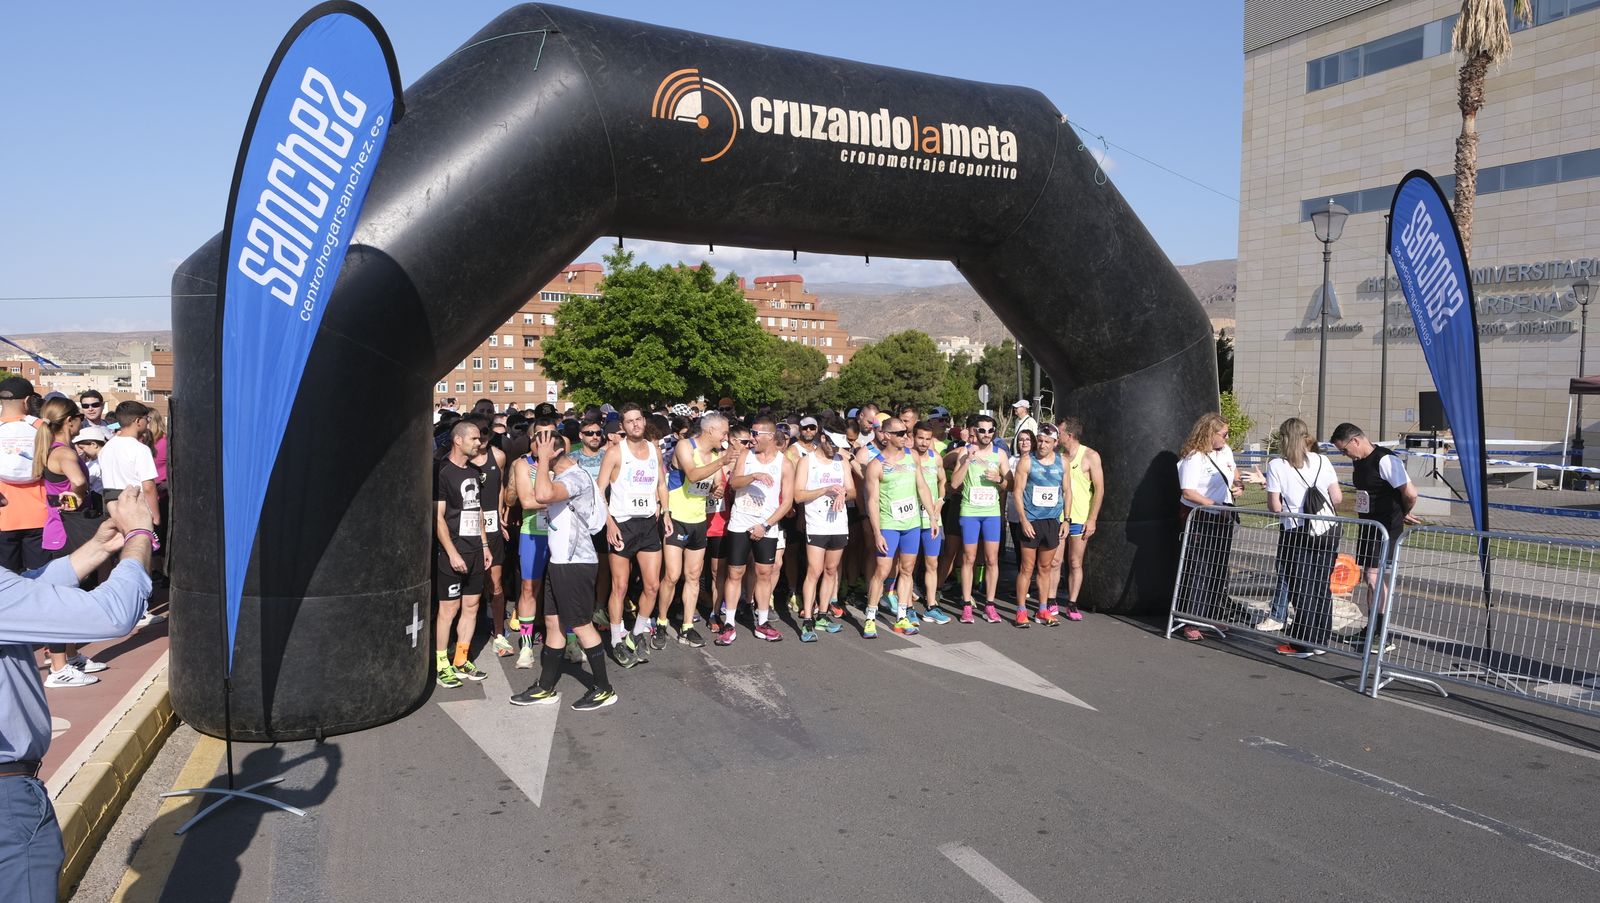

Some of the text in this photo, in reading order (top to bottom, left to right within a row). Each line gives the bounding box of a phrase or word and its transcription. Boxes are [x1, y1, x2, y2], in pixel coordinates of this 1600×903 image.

[840, 149, 1018, 180] cronometraje deportivo
[1471, 258, 1600, 284] NIVERSITARI
[695, 481, 710, 490] 109
[1041, 493, 1054, 501] 62
[631, 498, 649, 507] 161
[898, 503, 914, 514] 100
